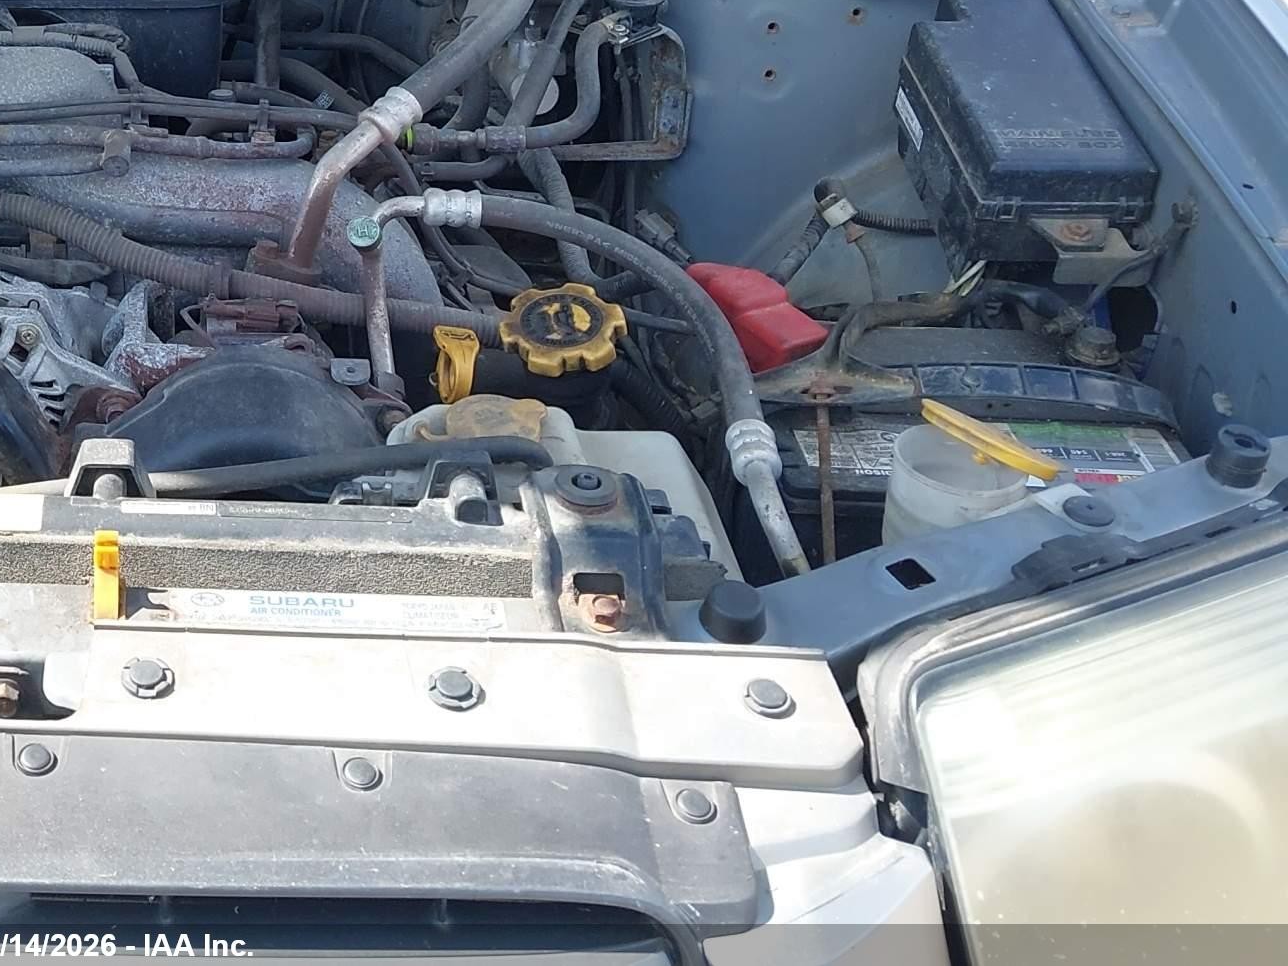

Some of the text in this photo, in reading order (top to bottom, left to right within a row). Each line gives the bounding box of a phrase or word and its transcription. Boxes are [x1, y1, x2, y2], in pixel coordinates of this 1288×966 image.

[249, 595, 355, 608] SUBARU
[250, 607, 342, 617] AIR CONDITIONER
